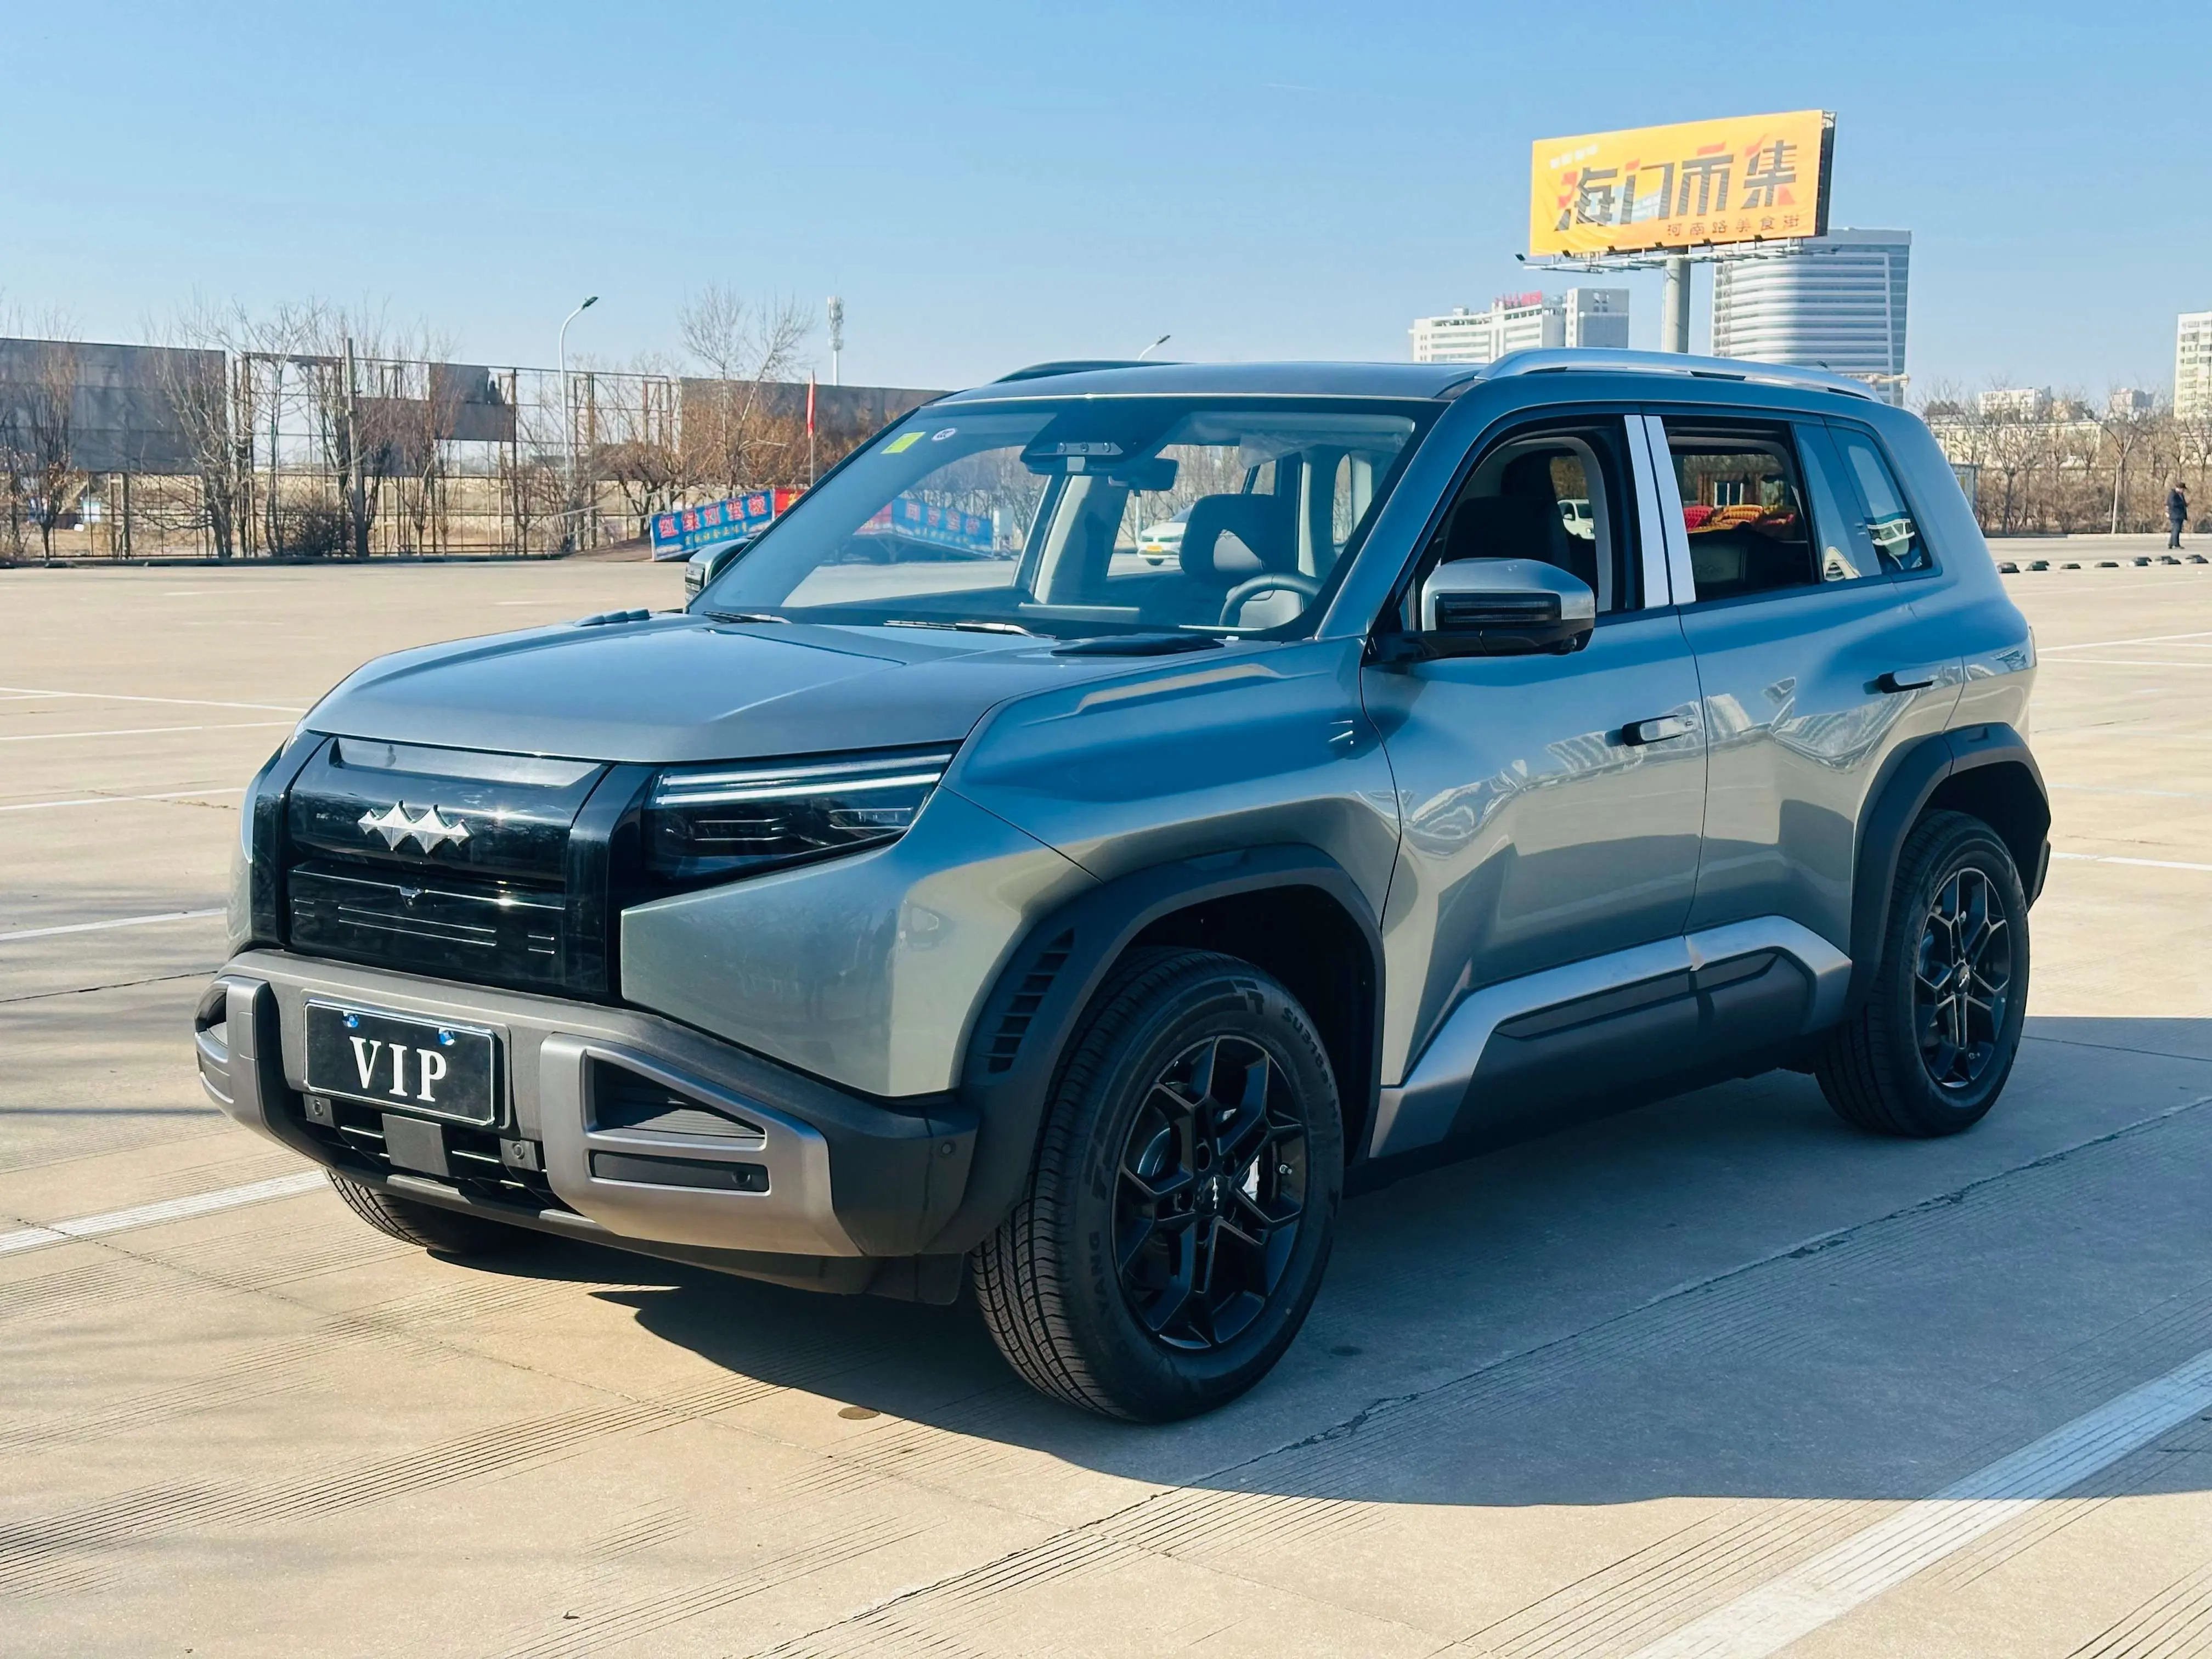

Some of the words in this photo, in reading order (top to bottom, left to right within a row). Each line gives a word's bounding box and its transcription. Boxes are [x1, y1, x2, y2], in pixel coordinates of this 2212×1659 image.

[1554, 133, 1797, 232] 海门市集
[659, 494, 767, 538] 红绿灯驾校
[349, 1036, 447, 1102] VIP
